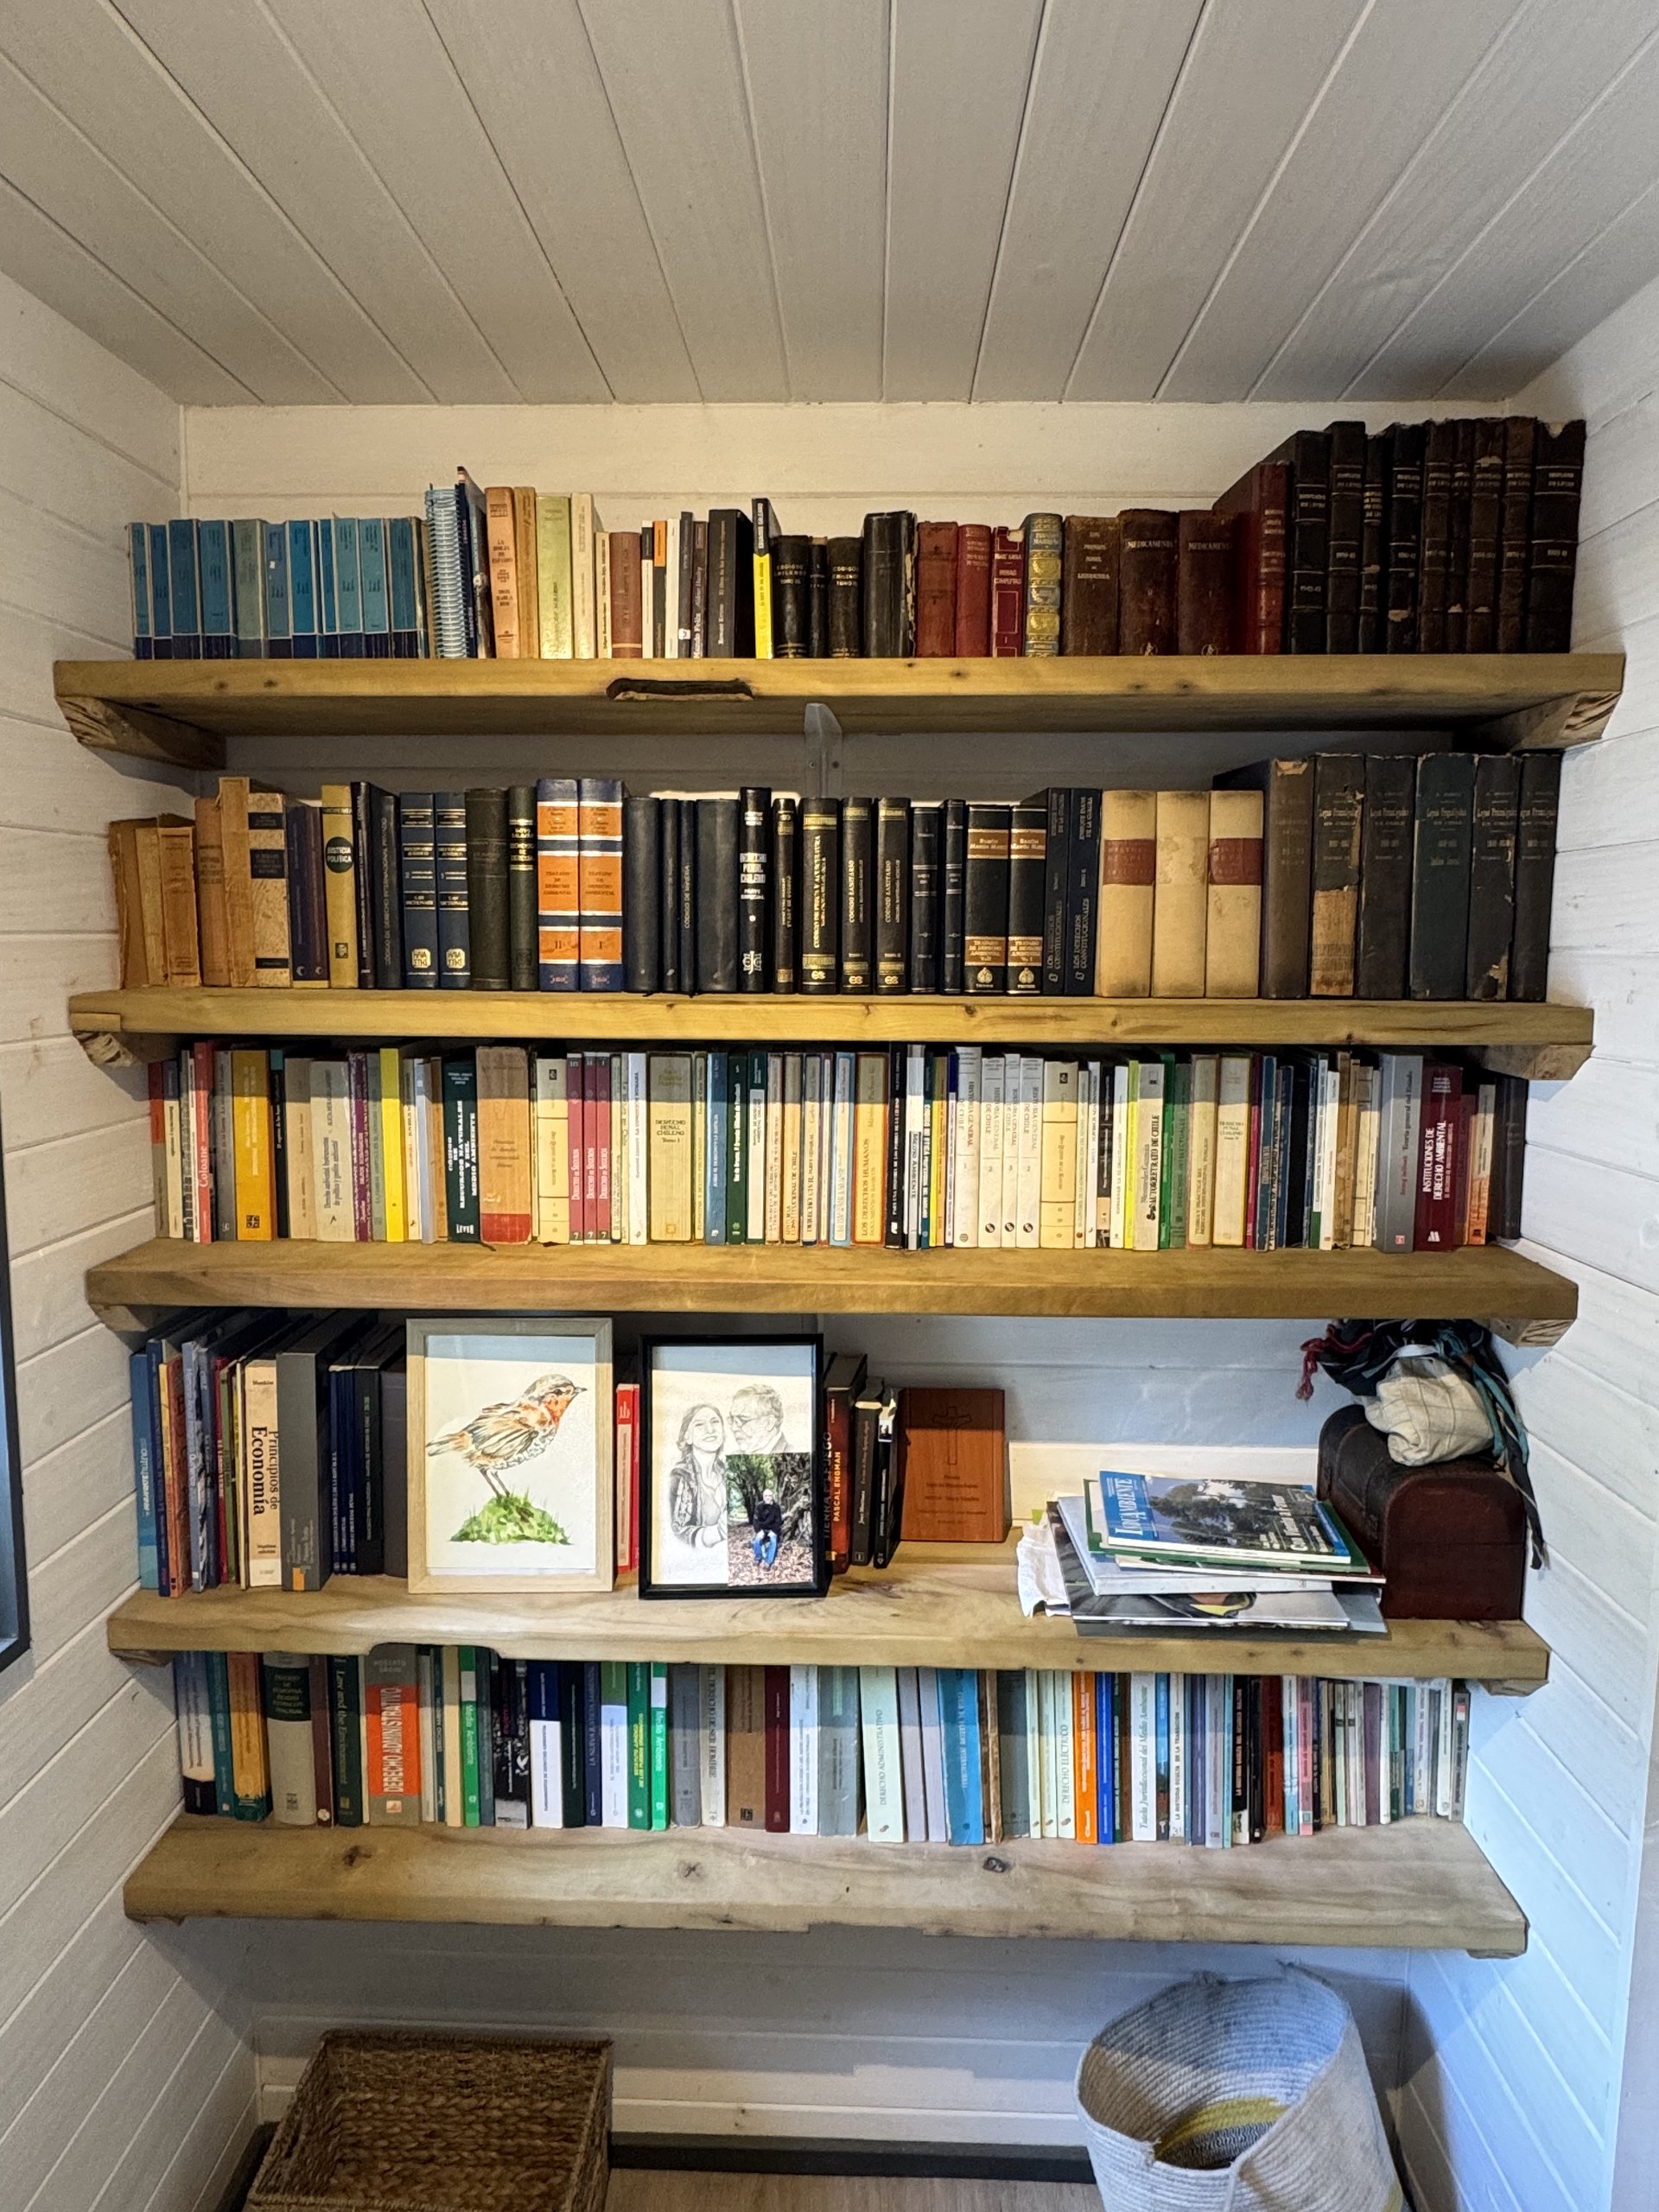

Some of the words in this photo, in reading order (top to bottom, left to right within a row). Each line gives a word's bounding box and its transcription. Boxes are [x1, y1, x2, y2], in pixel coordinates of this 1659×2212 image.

[1425, 1128, 1434, 1138] DE
[1434, 1121, 1446, 1163] AMBIENTAL
[199, 1146, 210, 1188] Coloane
[1422, 1139, 1433, 1192] INSTITUCIONES
[1433, 1165, 1444, 1200] DERECHO
[251, 1426, 269, 1515] Economía
[270, 1496, 279, 1510] de
[380, 1687, 403, 1753] ADMINISTRATIVO
[382, 1755, 404, 1793] DERECHO
[878, 1771, 887, 1805] DERECHO
